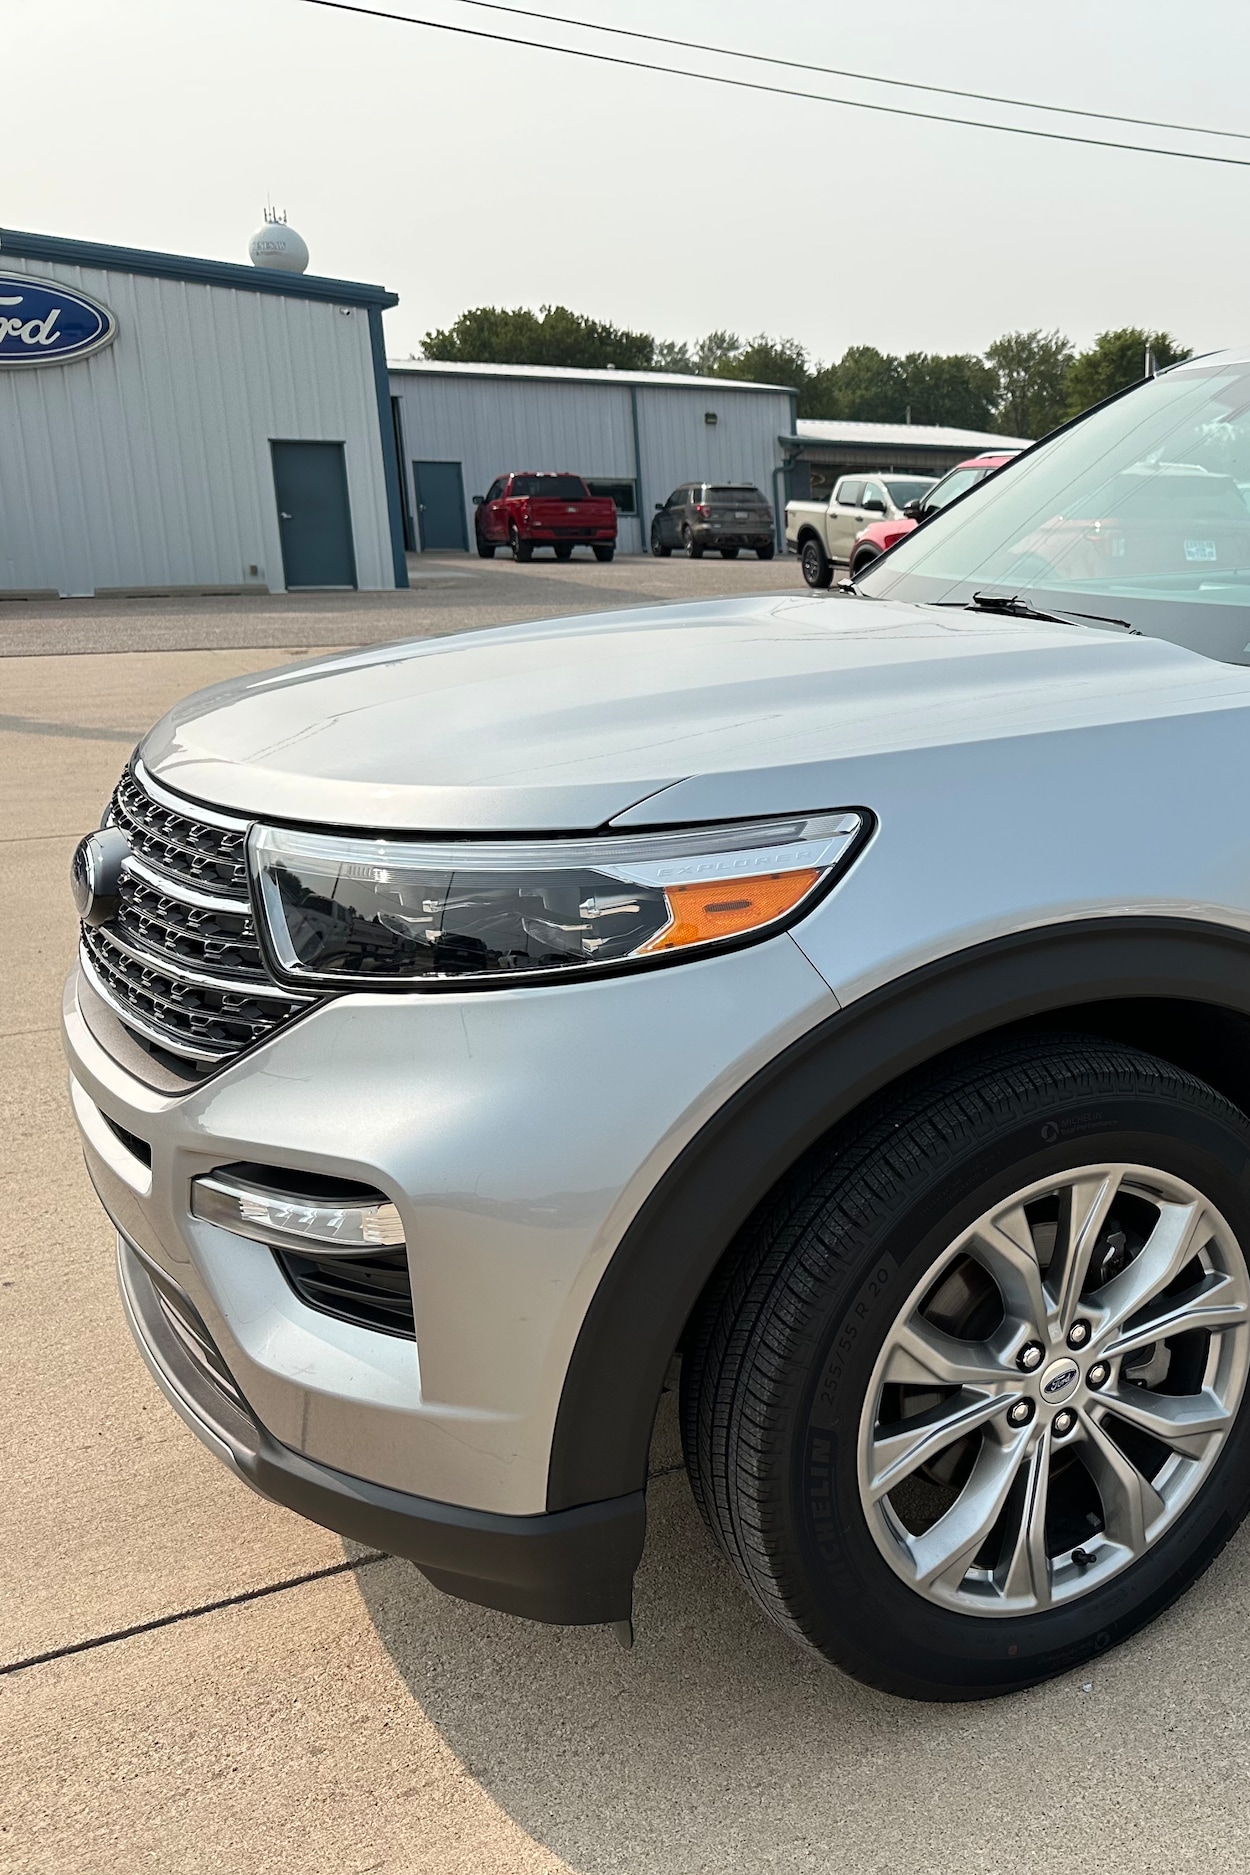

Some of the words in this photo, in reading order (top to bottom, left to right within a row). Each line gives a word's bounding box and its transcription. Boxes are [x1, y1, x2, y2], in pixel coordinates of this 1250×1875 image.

[657, 850, 813, 877] EXPLORER
[1061, 1111, 1103, 1129] MICHELIN
[820, 1323, 858, 1406] 255/55
[855, 1302, 870, 1320] R
[868, 1268, 889, 1298] 20
[1050, 1372, 1071, 1391] Ford
[809, 1437, 860, 1598] MICHELIN
